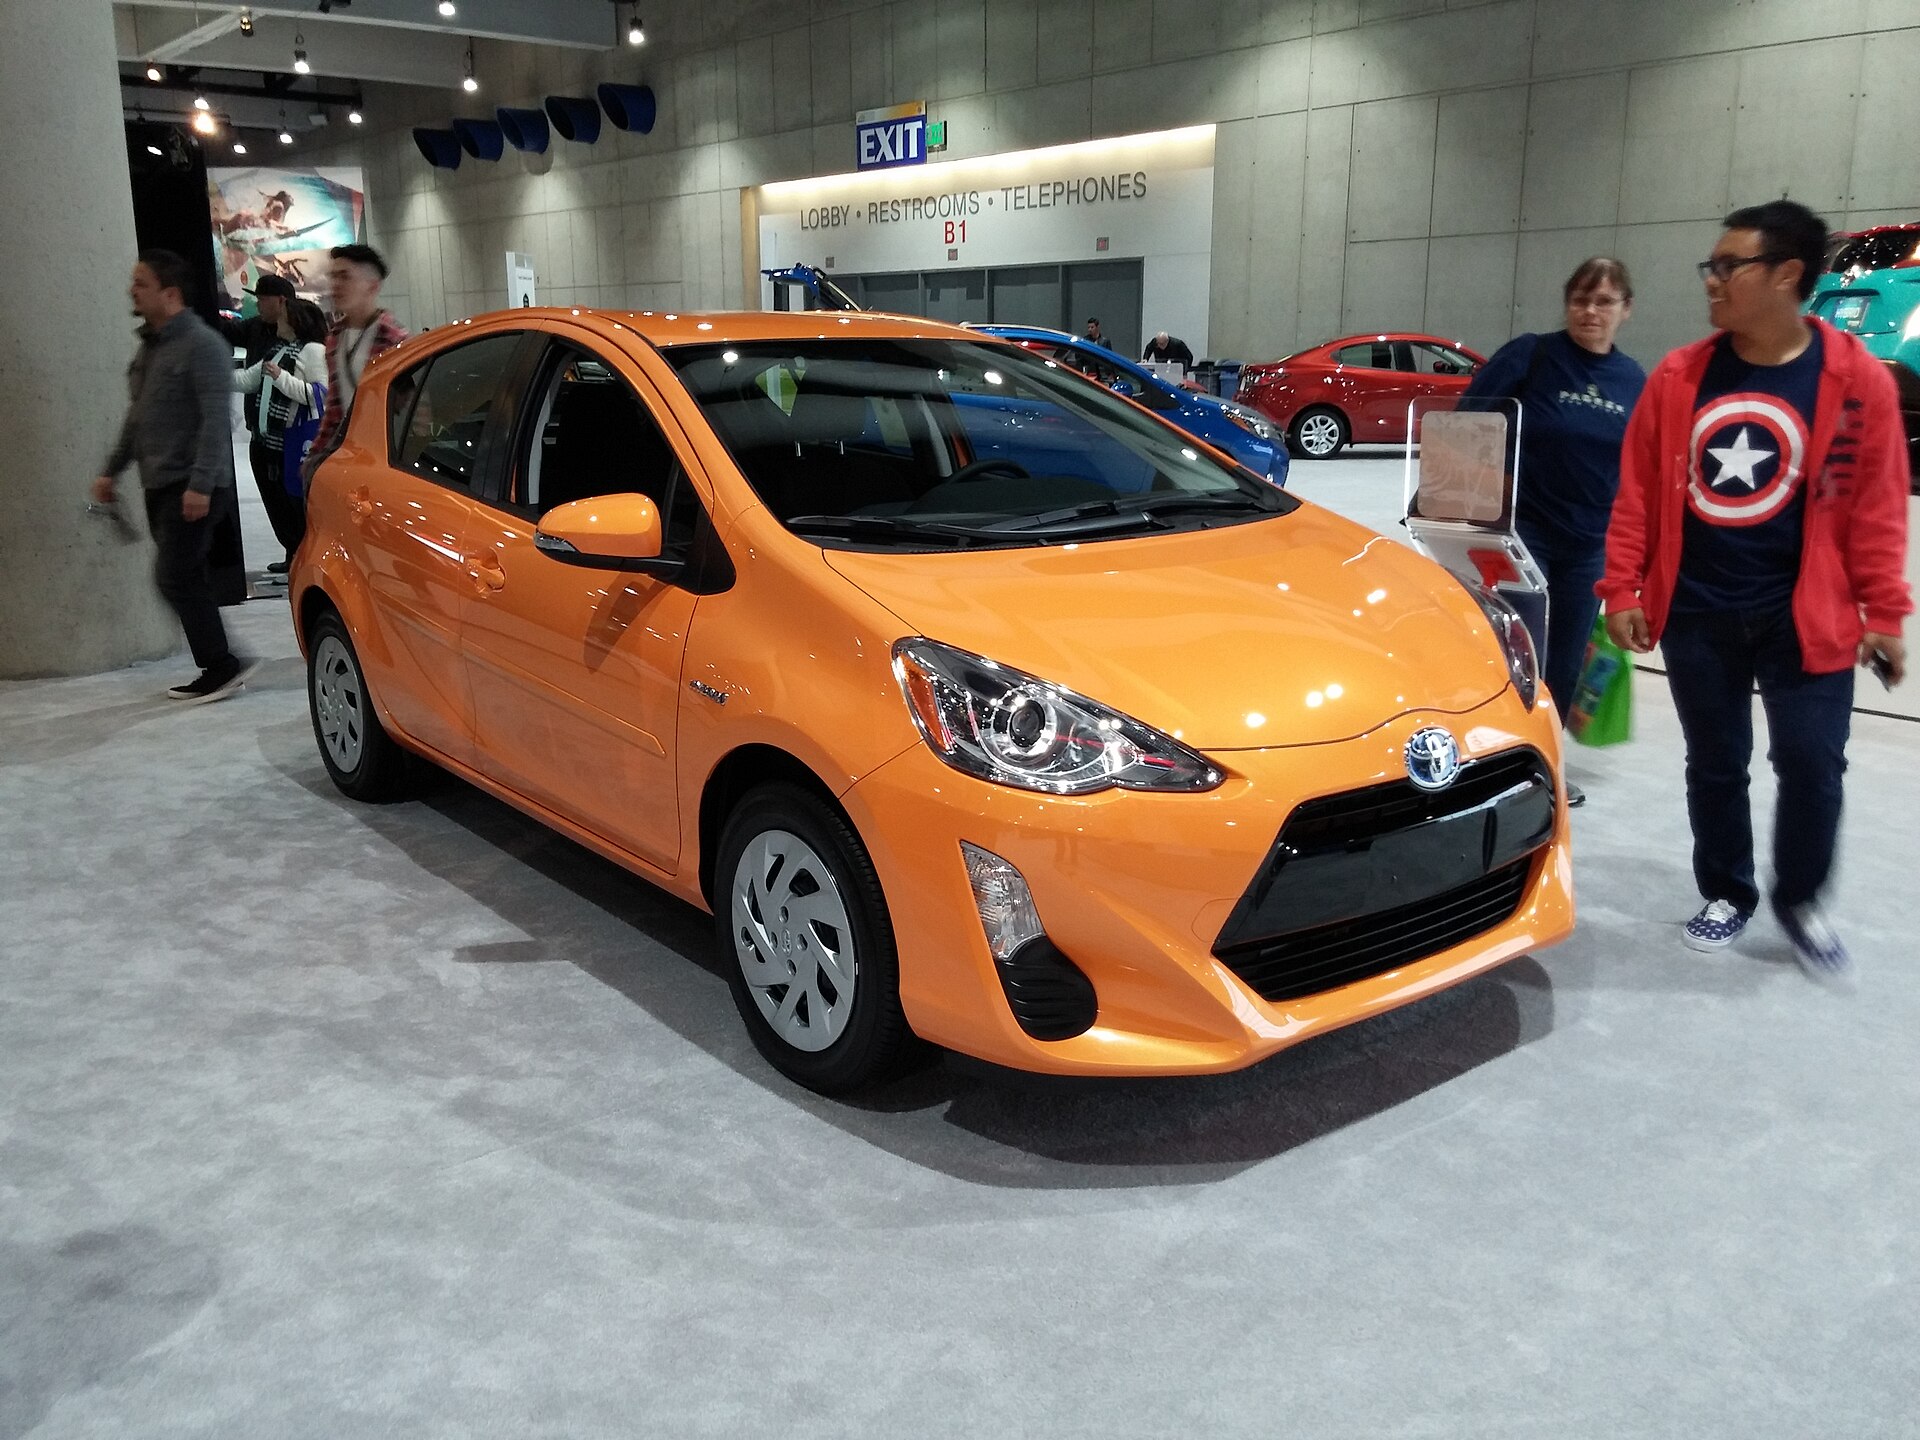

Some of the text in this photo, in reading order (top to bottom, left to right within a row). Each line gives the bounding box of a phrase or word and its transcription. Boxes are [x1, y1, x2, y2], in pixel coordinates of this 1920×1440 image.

[860, 121, 923, 165] EXIT
[800, 171, 1147, 231] LOBBY RESTROOMS TELEPHONES
[944, 219, 967, 245] B1
